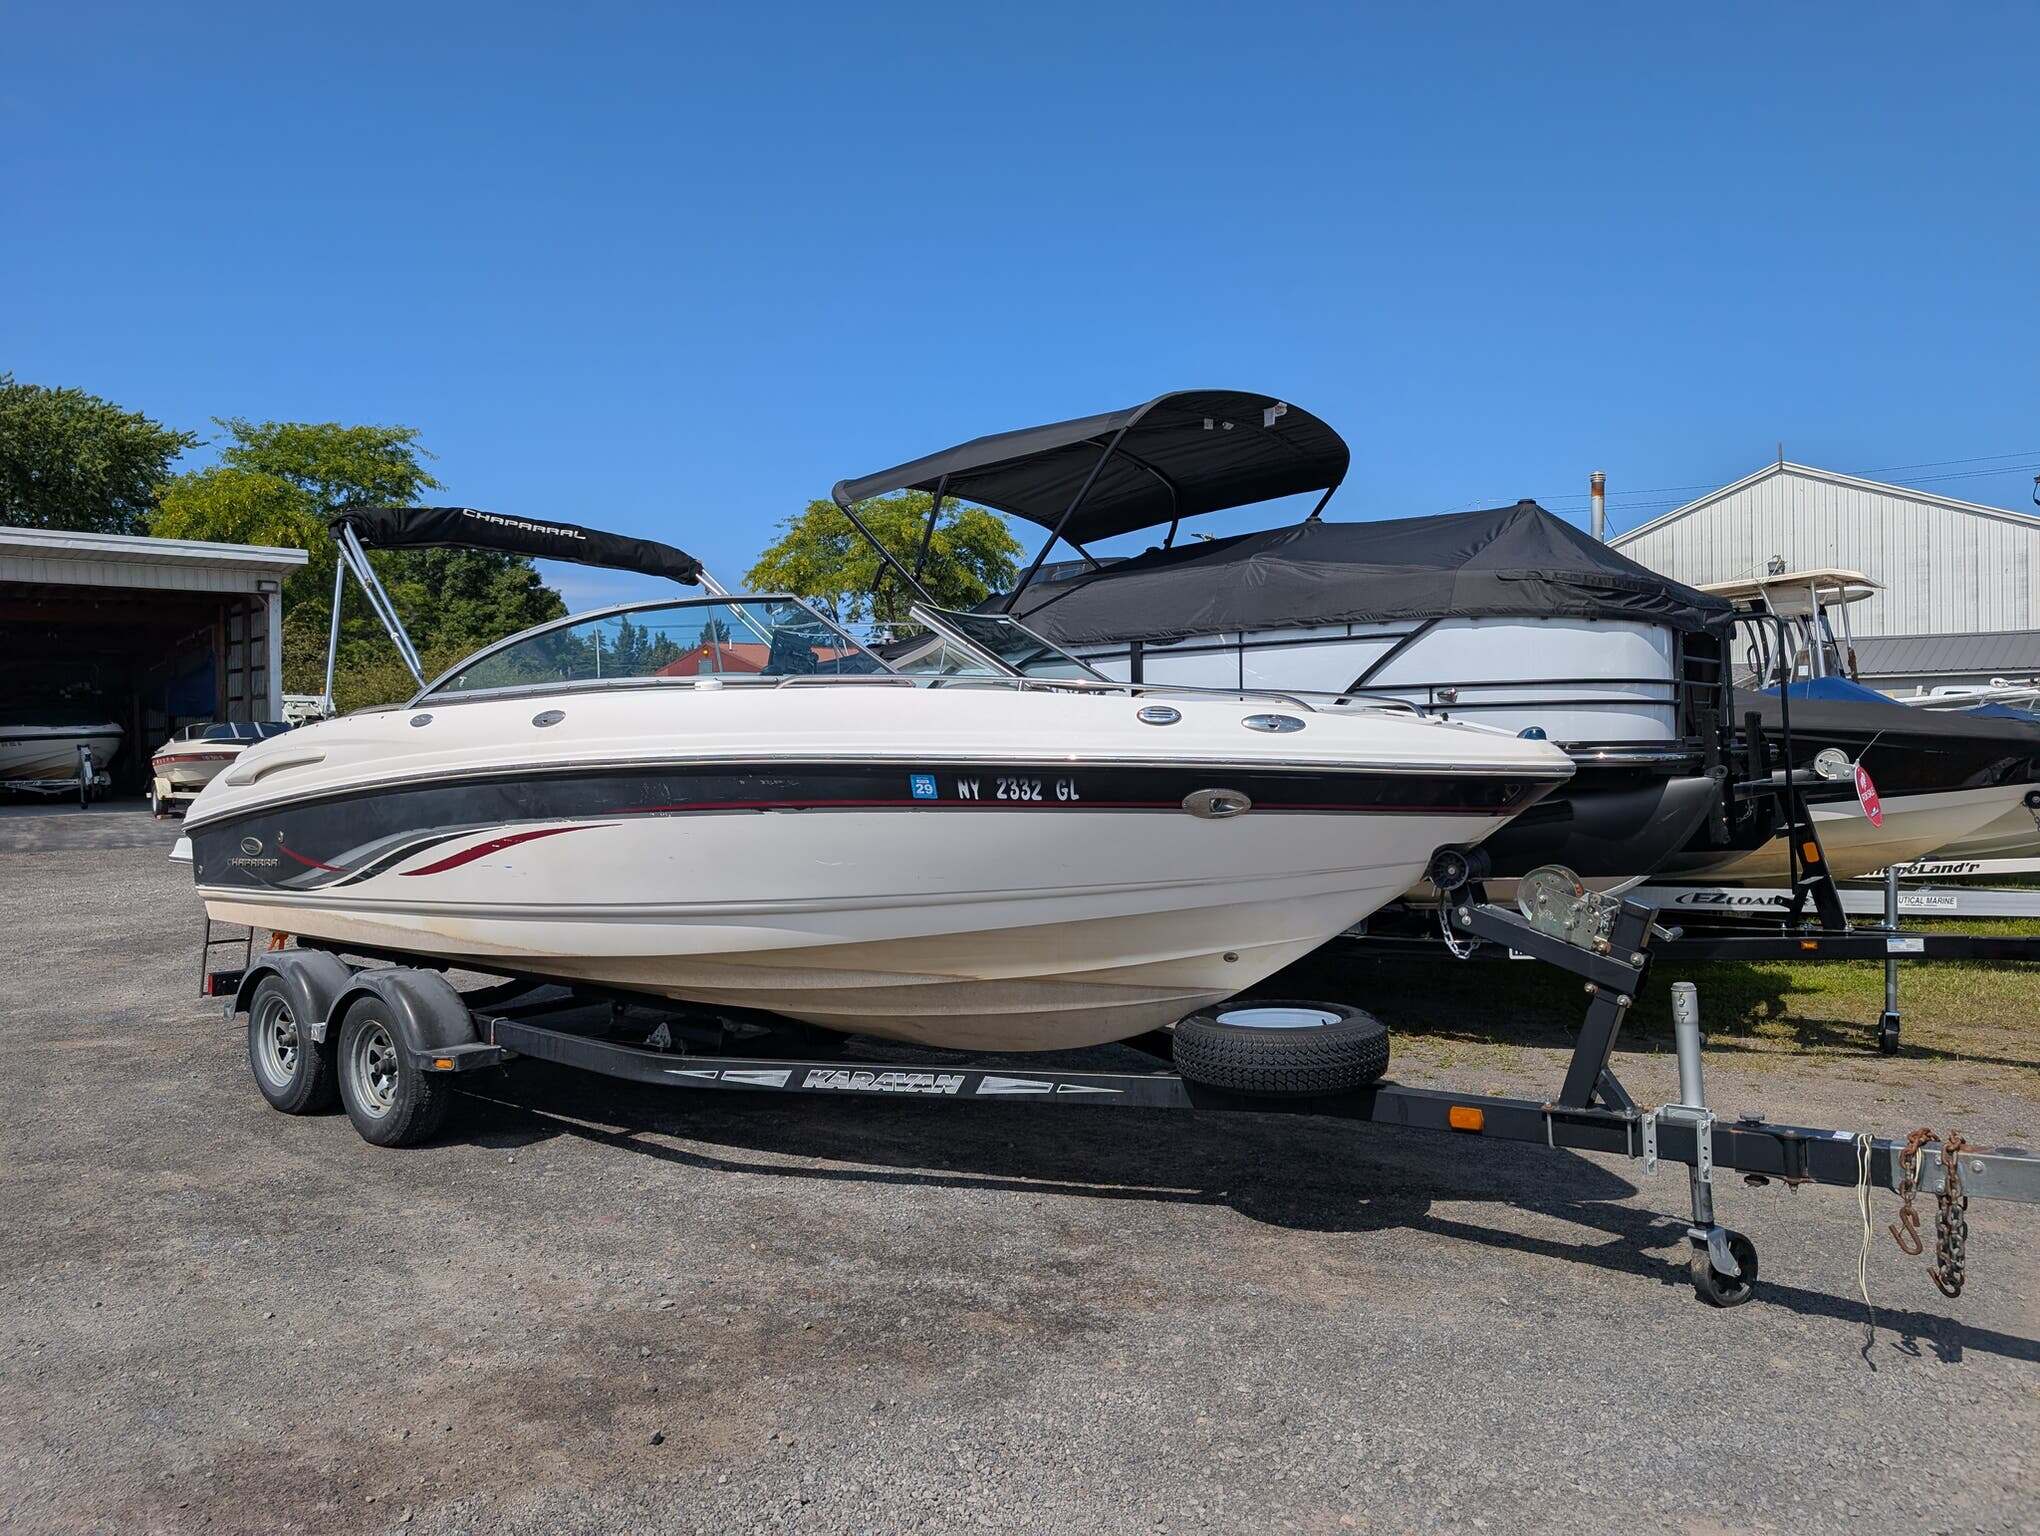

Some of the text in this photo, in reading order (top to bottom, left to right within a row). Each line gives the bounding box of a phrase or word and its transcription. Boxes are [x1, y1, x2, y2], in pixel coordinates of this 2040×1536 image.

[462, 508, 587, 540] CHAPARRAL
[915, 783, 934, 795] 29
[957, 777, 1080, 801] NY 2332 GL
[1898, 896, 1955, 905] UTICAL MARINE
[802, 1069, 966, 1095] KARAVAN
